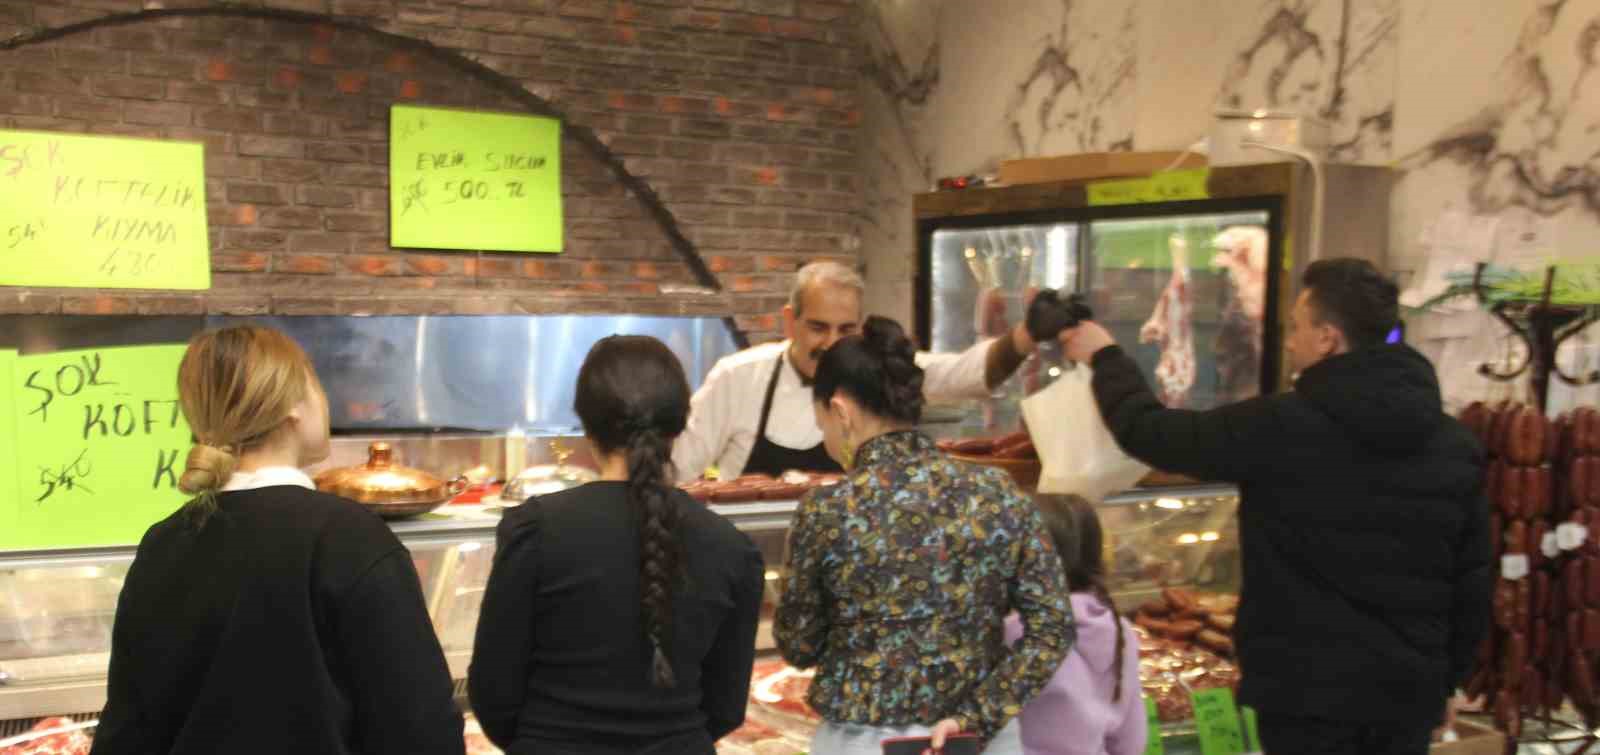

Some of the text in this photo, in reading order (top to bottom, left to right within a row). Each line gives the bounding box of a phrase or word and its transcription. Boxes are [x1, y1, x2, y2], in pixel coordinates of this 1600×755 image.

[440, 176, 489, 205] 500
[504, 178, 528, 198] TL
[8, 217, 47, 249] 54
[24, 352, 119, 423] ŞOK
